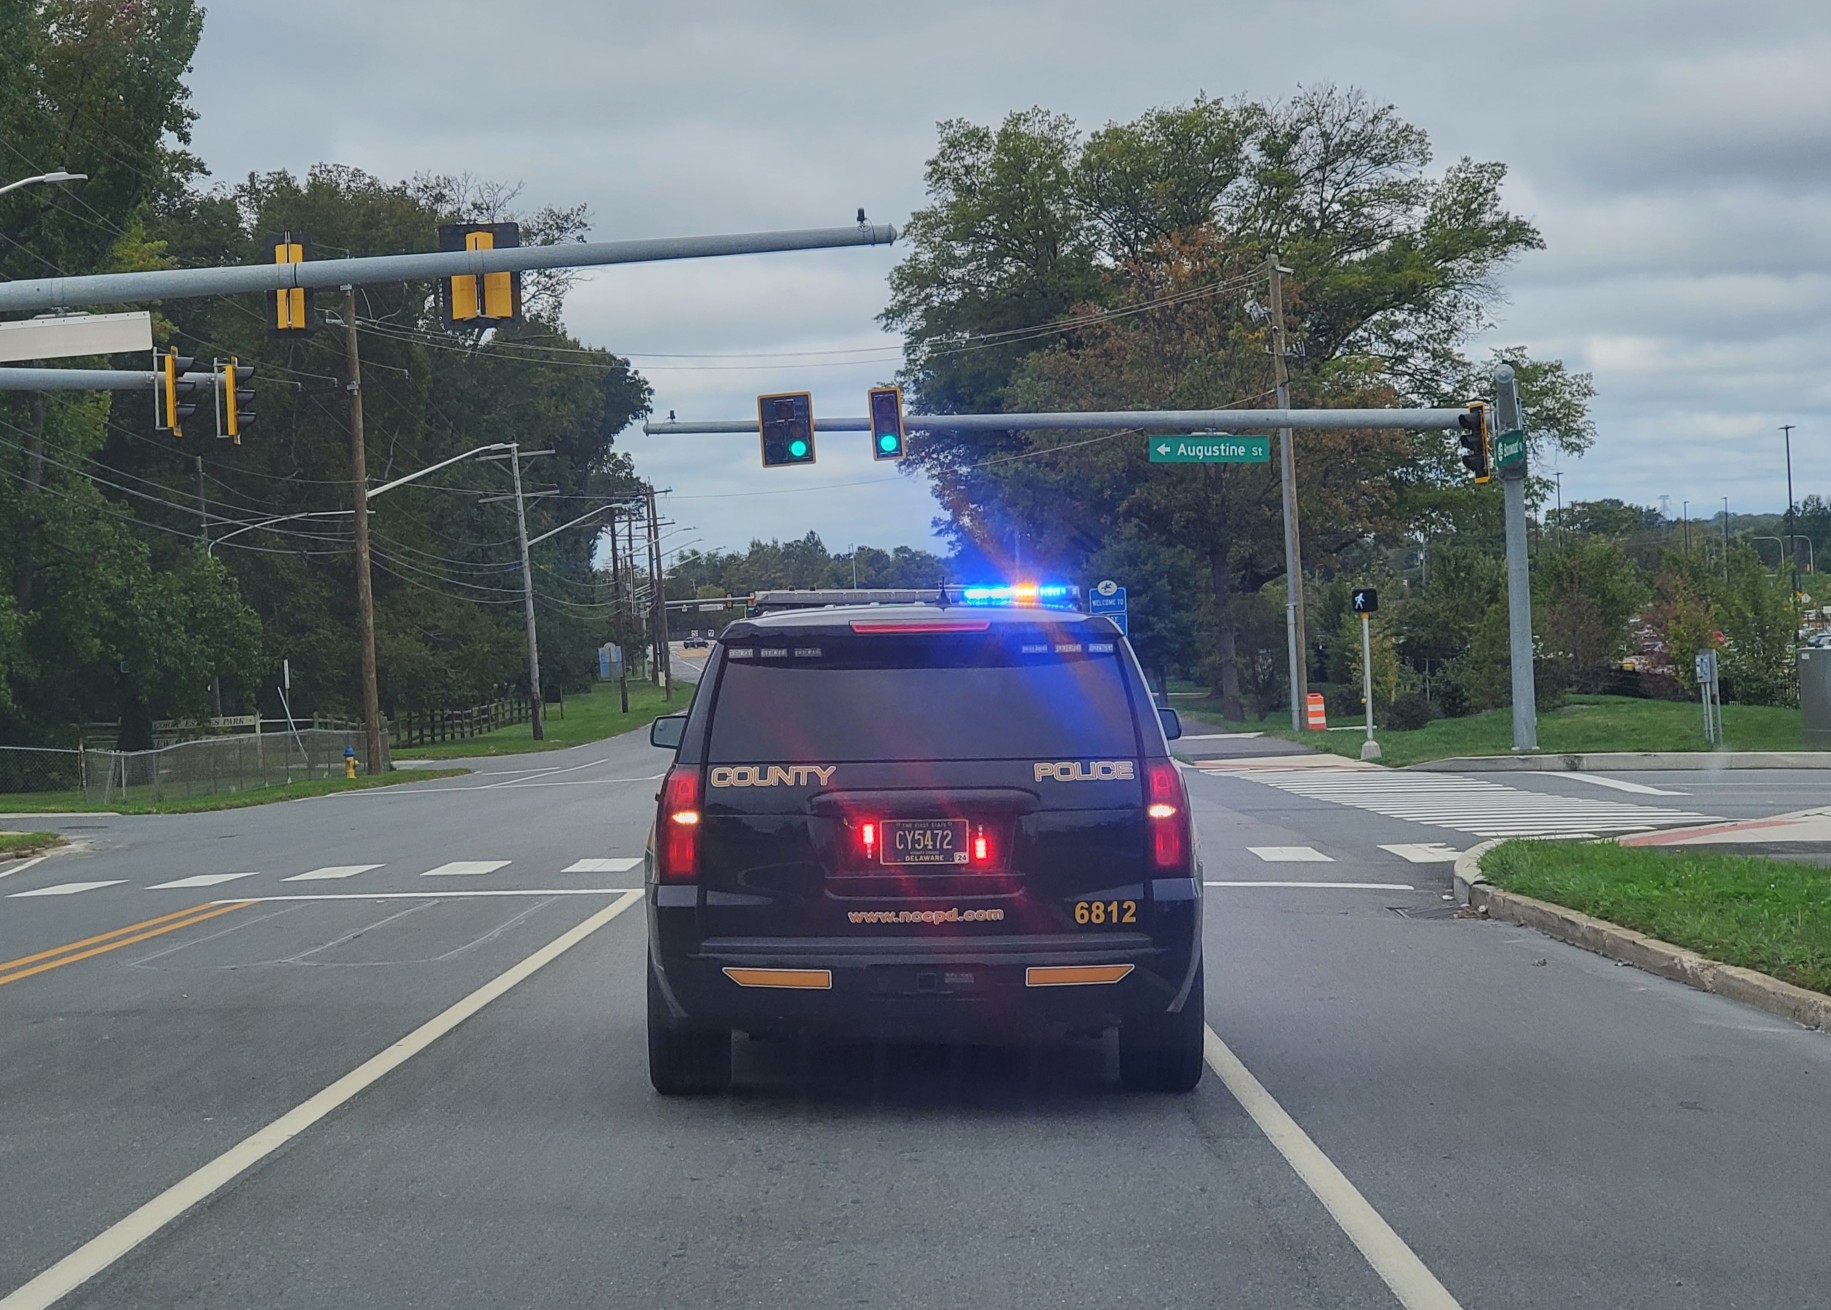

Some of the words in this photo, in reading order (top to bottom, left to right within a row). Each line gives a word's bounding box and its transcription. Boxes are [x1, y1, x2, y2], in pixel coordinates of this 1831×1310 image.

[1177, 443, 1246, 460] Augustine
[1251, 446, 1263, 456] St
[711, 766, 837, 787] COUNTY
[1034, 761, 1134, 782] POLICE
[896, 830, 952, 850] CY5472
[1074, 901, 1136, 924] 6812
